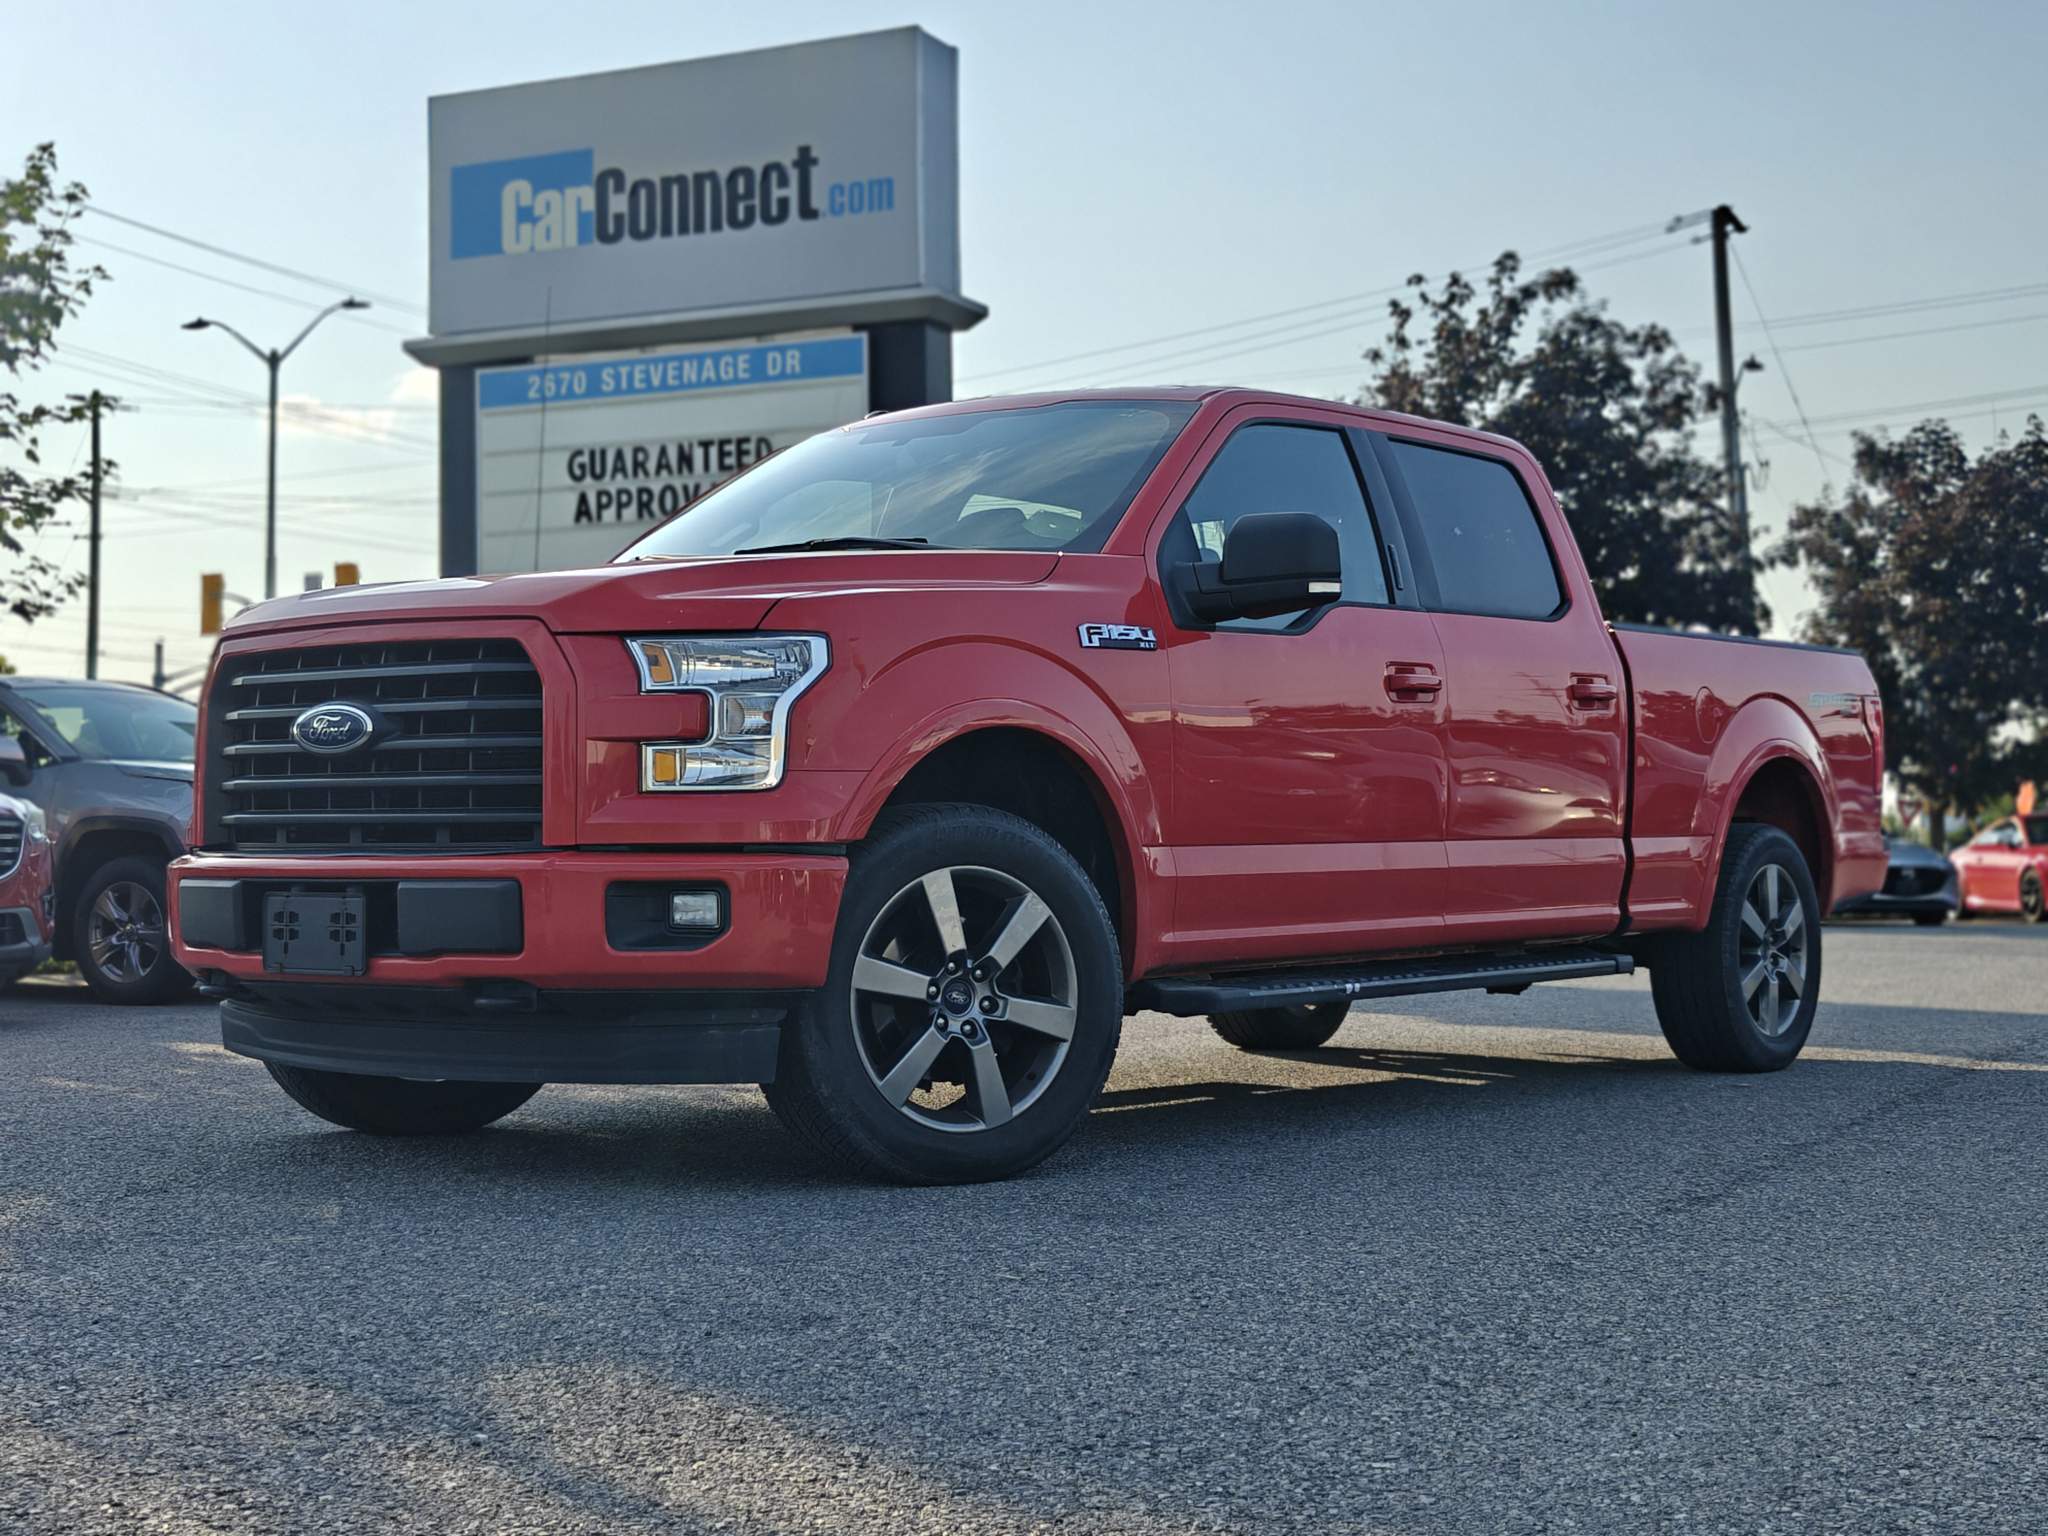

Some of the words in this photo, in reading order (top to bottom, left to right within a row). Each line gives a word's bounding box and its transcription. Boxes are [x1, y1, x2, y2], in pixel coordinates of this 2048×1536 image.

[527, 370, 588, 400] 2670
[601, 351, 751, 393] STEVENAGE
[766, 349, 802, 376] DR
[574, 482, 718, 524] APPROV
[309, 715, 352, 740] Ford
